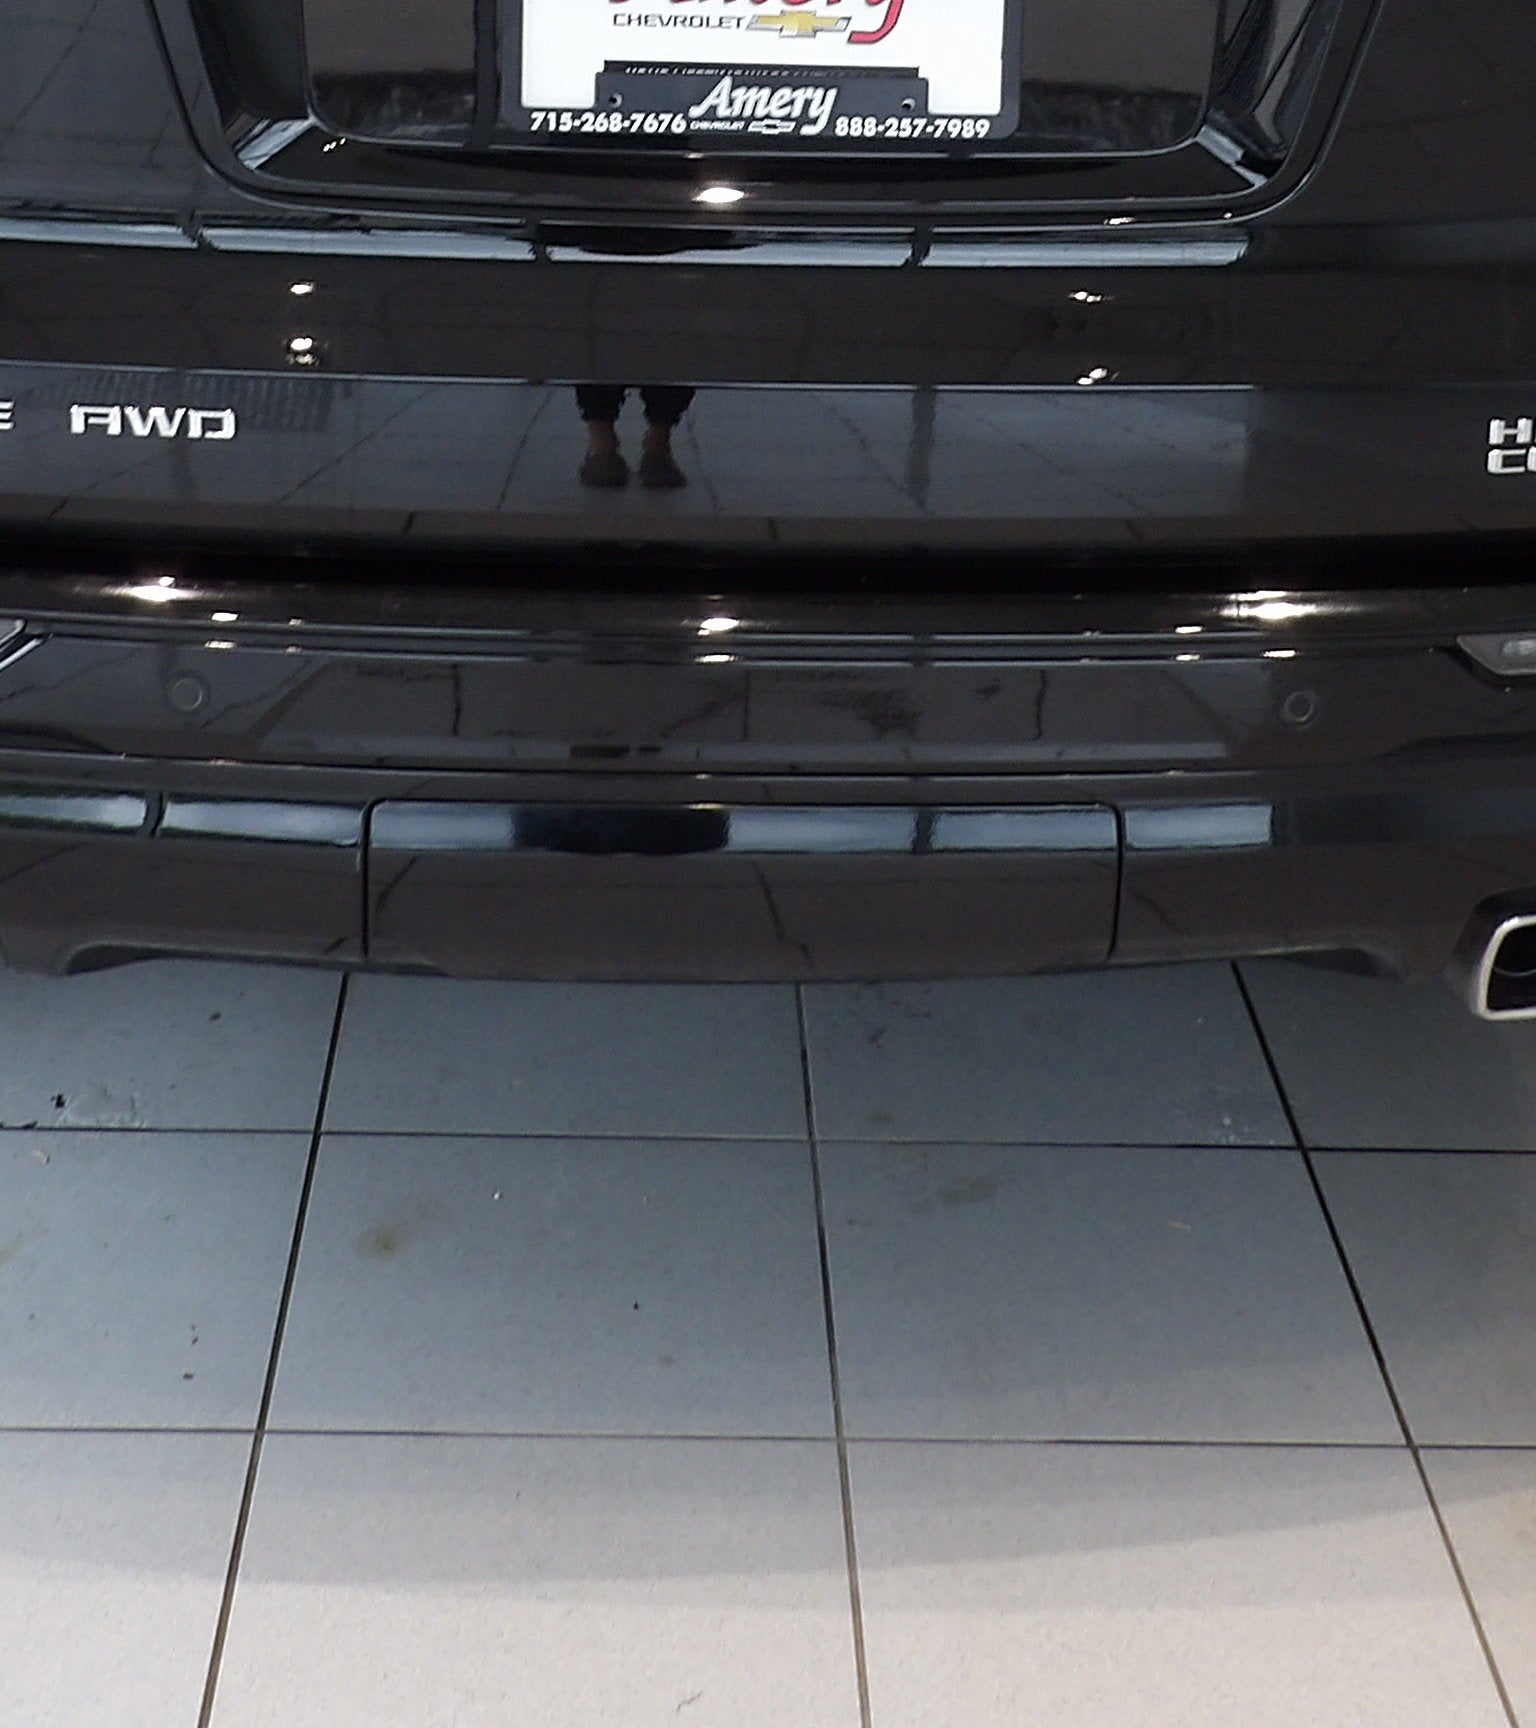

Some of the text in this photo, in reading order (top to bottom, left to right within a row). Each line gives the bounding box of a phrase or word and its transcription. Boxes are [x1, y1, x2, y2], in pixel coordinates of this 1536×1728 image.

[612, 12, 746, 30] CHEVROLET
[688, 75, 838, 135] Amery
[530, 111, 687, 134] 715-268-7676
[834, 115, 990, 139] 888-257-7989
[69, 402, 238, 441] AWD
